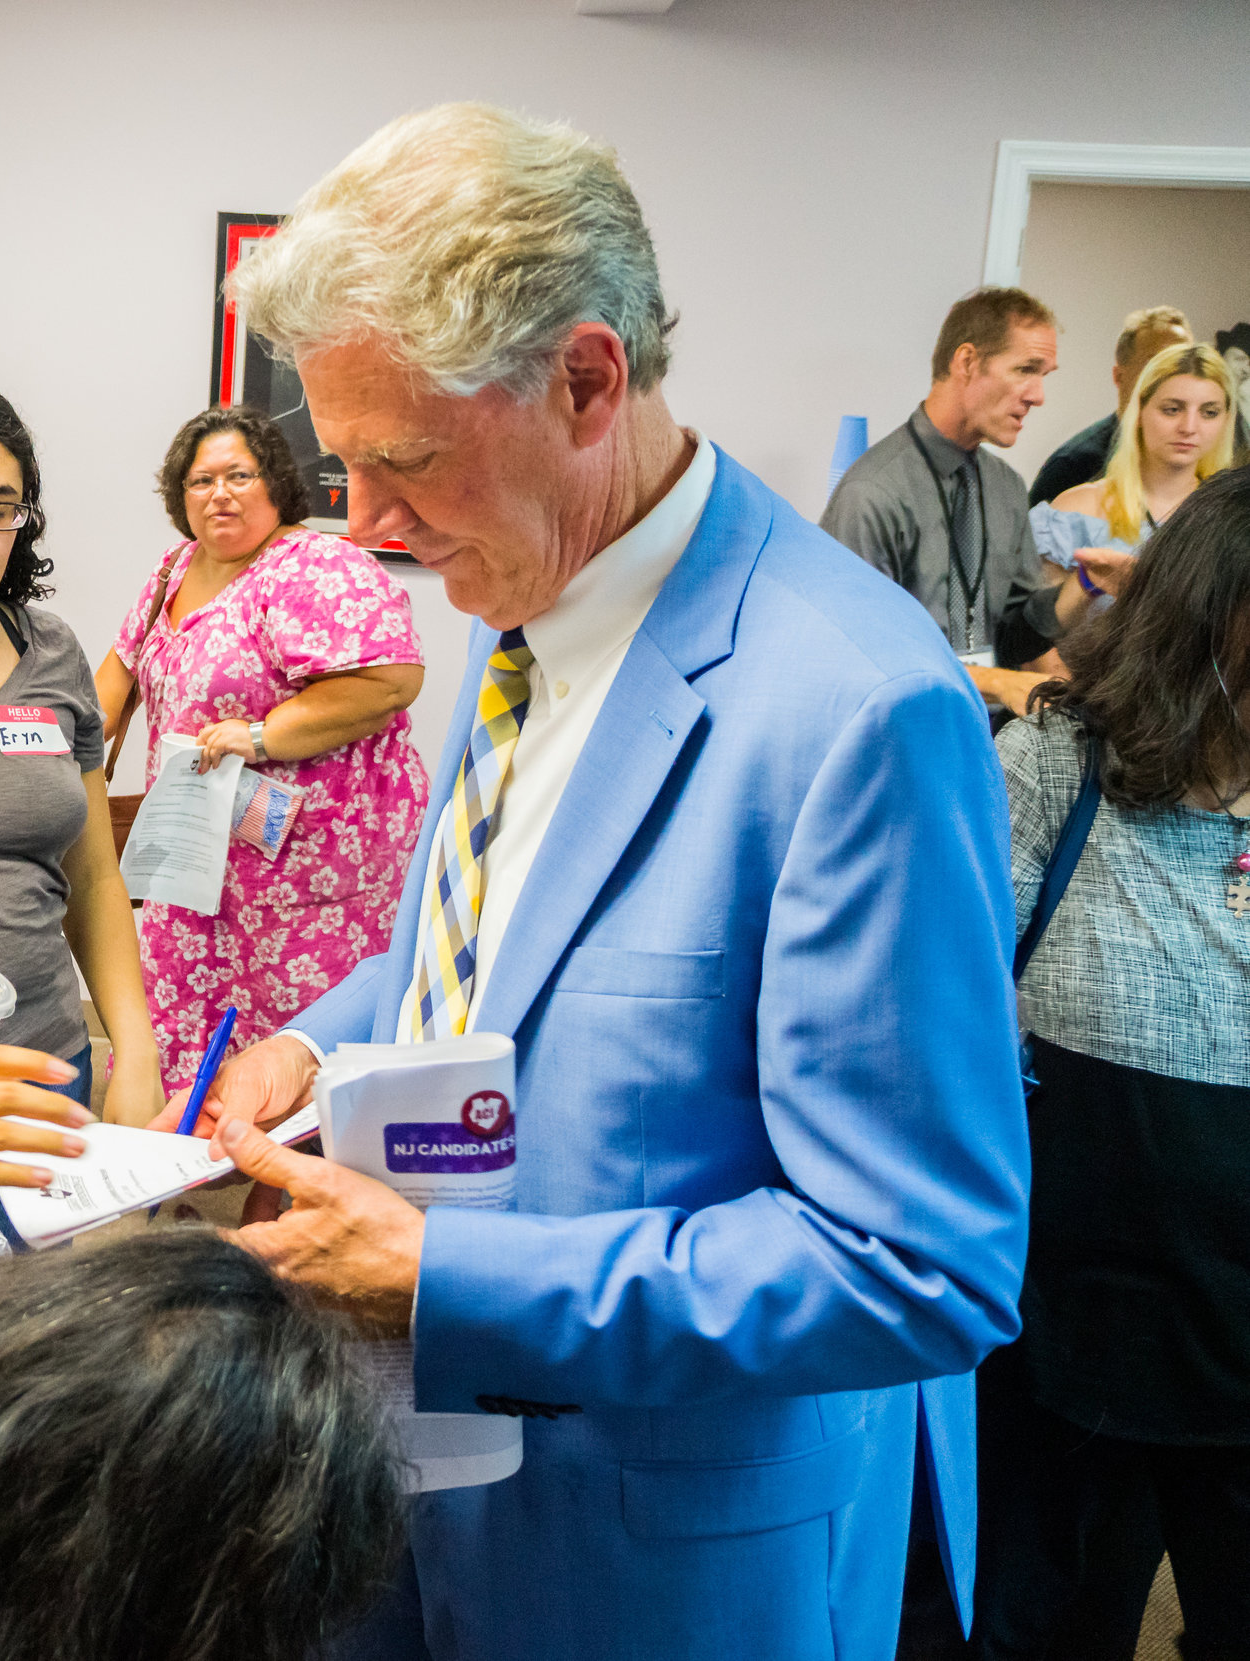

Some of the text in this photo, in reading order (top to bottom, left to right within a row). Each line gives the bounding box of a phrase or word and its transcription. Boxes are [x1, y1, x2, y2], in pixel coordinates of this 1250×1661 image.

[8, 707, 41, 717] HELLO
[0, 727, 43, 746] Eryn
[263, 786, 291, 850] POPCORN
[393, 1134, 516, 1157] NJ CANDIDATES
